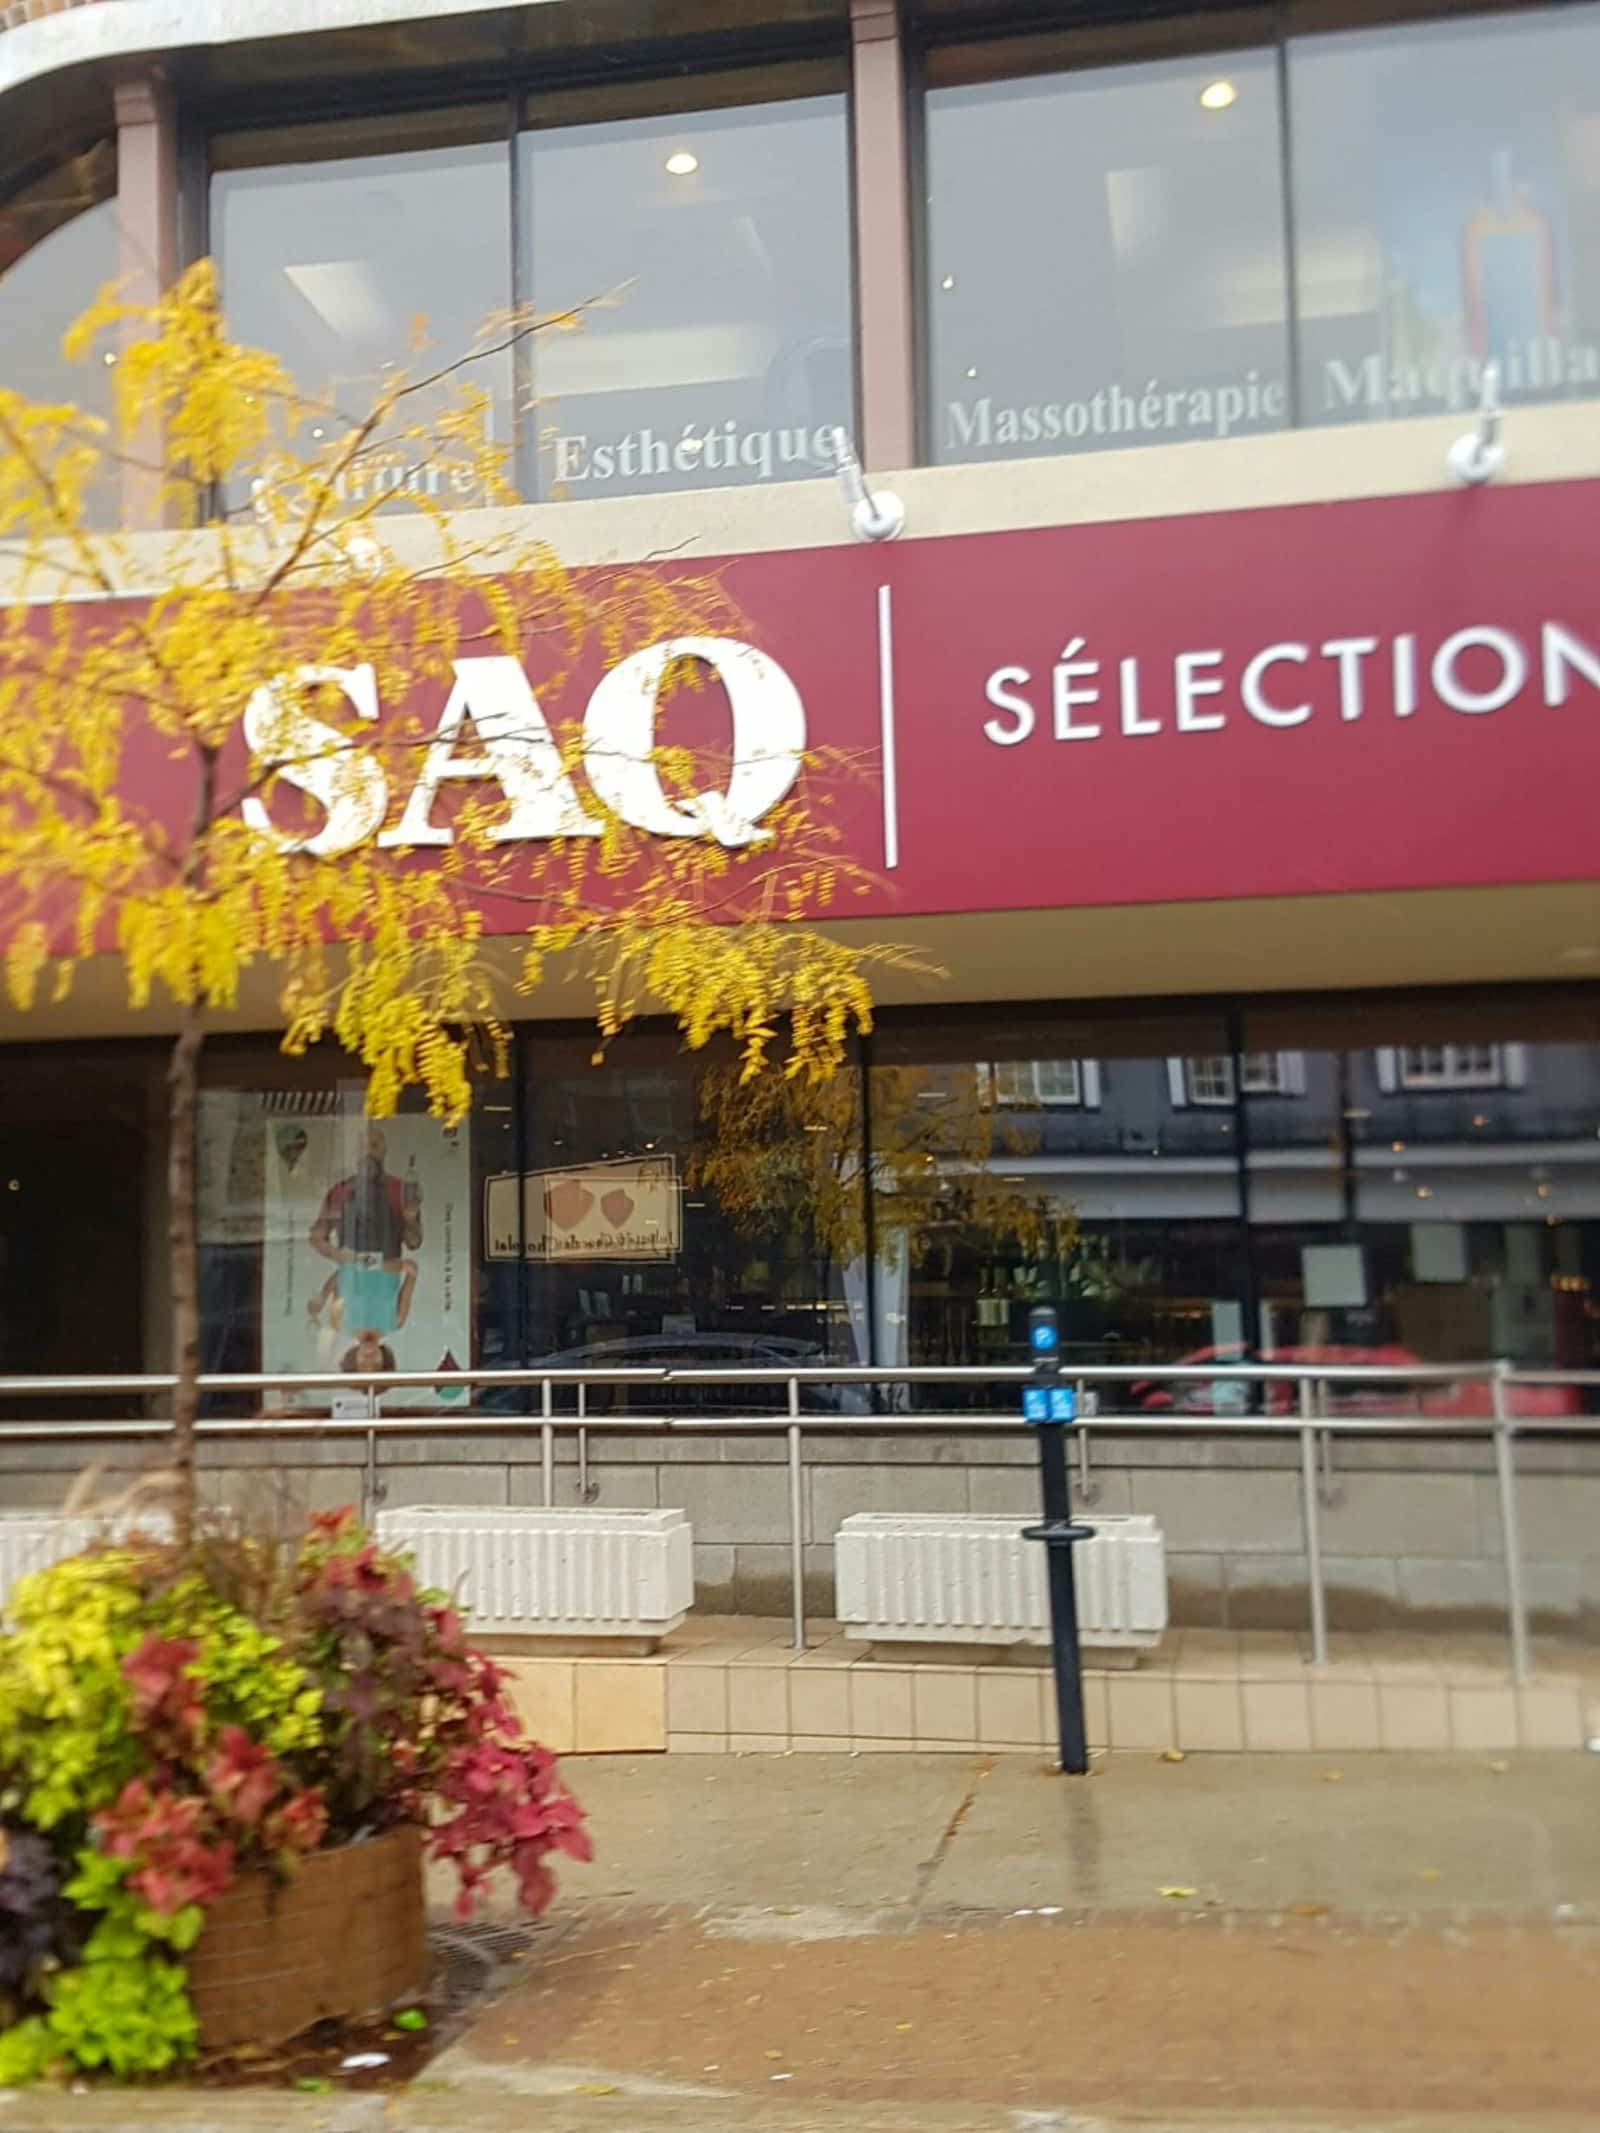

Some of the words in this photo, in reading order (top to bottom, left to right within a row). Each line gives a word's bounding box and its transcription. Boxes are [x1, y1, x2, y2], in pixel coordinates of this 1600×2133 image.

[945, 368, 1285, 450] Massothérapie
[552, 419, 844, 482] Esthétique
[242, 636, 807, 858] SAQ
